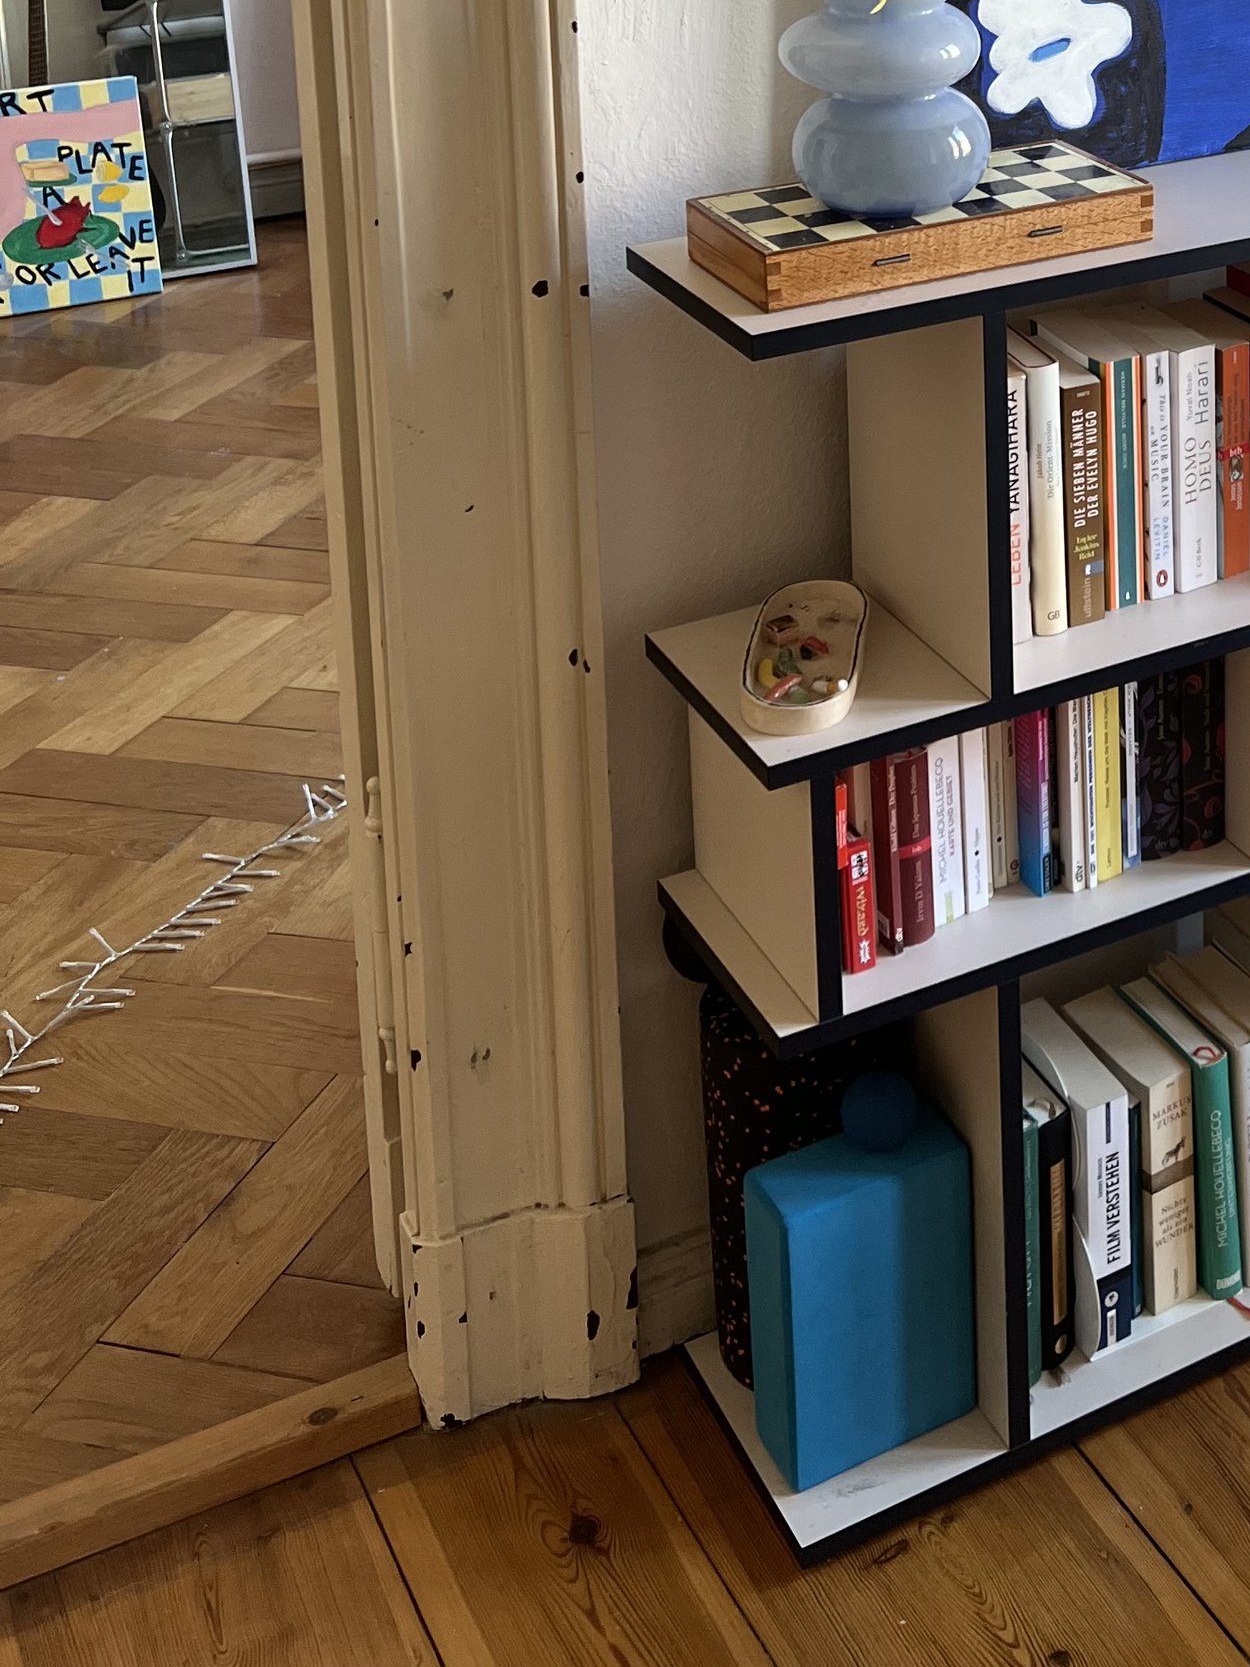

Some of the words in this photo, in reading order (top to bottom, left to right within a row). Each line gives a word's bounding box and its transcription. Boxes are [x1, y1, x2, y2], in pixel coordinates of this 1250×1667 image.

[57, 141, 144, 181] PLATE
[43, 186, 65, 208] A
[15, 263, 62, 287] OR
[67, 220, 154, 280] LEAVE
[127, 256, 155, 293] IT
[1185, 371, 1193, 395] Noah
[1193, 360, 1210, 425] Harari
[1085, 411, 1099, 444] HUGO
[1185, 396, 1194, 422] Yuval
[1008, 389, 1021, 514] YANAGIHARA
[1070, 408, 1085, 458] MÄNNER
[1160, 426, 1170, 465] YOUR
[1086, 449, 1099, 490] EVELYN
[1150, 439, 1160, 483] MUSIC
[1184, 436, 1197, 505] HOMO
[1197, 440, 1213, 492] DEUS
[1047, 485, 1055, 499] Die
[1073, 462, 1086, 504] SIEBEN
[1160, 468, 1170, 509] BRAIN
[1074, 505, 1086, 528] DIE
[1088, 495, 1100, 518] DER
[1009, 523, 1022, 586] LEBEN
[1152, 517, 1162, 562] LEVITIN
[1161, 516, 1170, 558] DANIEL
[1047, 610, 1060, 621] GB
[1082, 576, 1093, 618] ullstein
[934, 757, 946, 839] HOUELLEBECQ
[936, 842, 948, 884] MICHEL
[1074, 864, 1082, 882] dtv
[1152, 1096, 1191, 1121] MARKUS
[1156, 1109, 1188, 1131] ZUSAK
[1210, 1109, 1226, 1200] HOUELLEBECQ
[1105, 1151, 1120, 1228] VERSTEHEN
[1155, 1223, 1194, 1248] WUNDER
[1217, 1204, 1229, 1248] MICHEL
[1106, 1231, 1121, 1265] FILM
